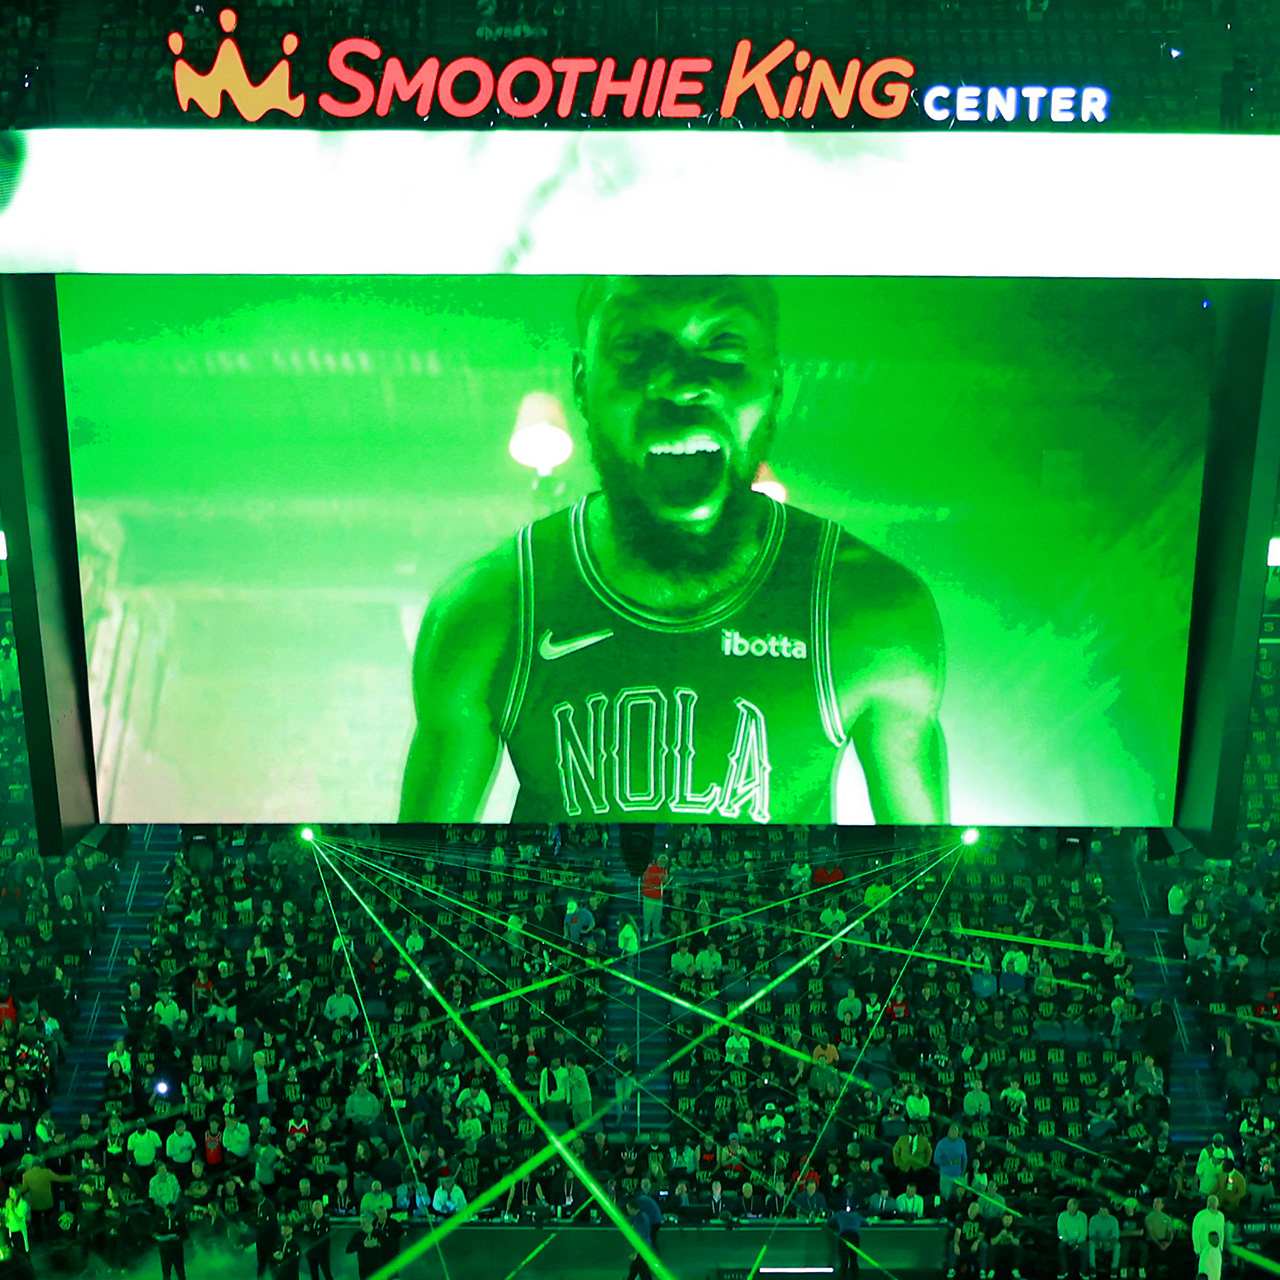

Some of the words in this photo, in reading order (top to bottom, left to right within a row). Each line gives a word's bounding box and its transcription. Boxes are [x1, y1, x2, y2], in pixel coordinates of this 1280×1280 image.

[319, 36, 711, 120] SMOOTHIE
[922, 85, 1109, 122] CENTER
[721, 628, 807, 660] ibotta
[552, 685, 772, 824] NOLA
